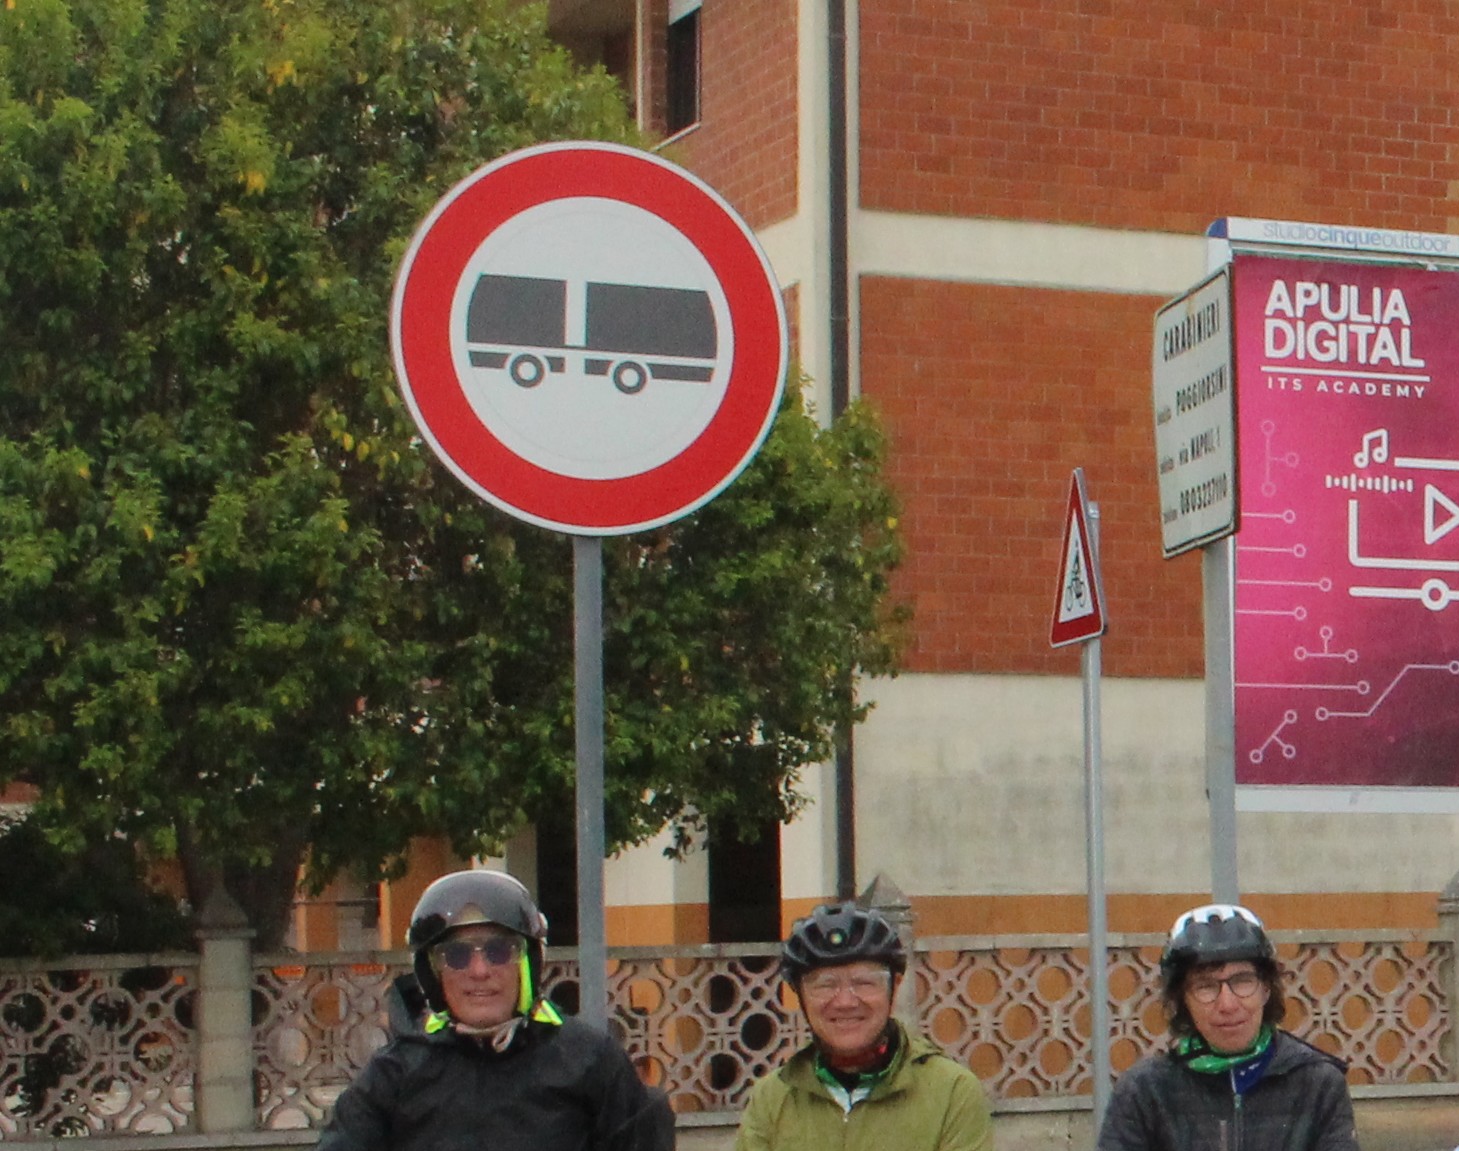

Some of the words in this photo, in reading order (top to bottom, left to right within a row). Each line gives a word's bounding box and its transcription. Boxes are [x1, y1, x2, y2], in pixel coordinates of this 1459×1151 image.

[1264, 279, 1412, 327] APULIA
[1163, 298, 1220, 362] CARABINIERI
[1264, 318, 1426, 368] DIGITAL
[1267, 375, 1303, 392] ITS
[1316, 379, 1427, 398] ACADEMY
